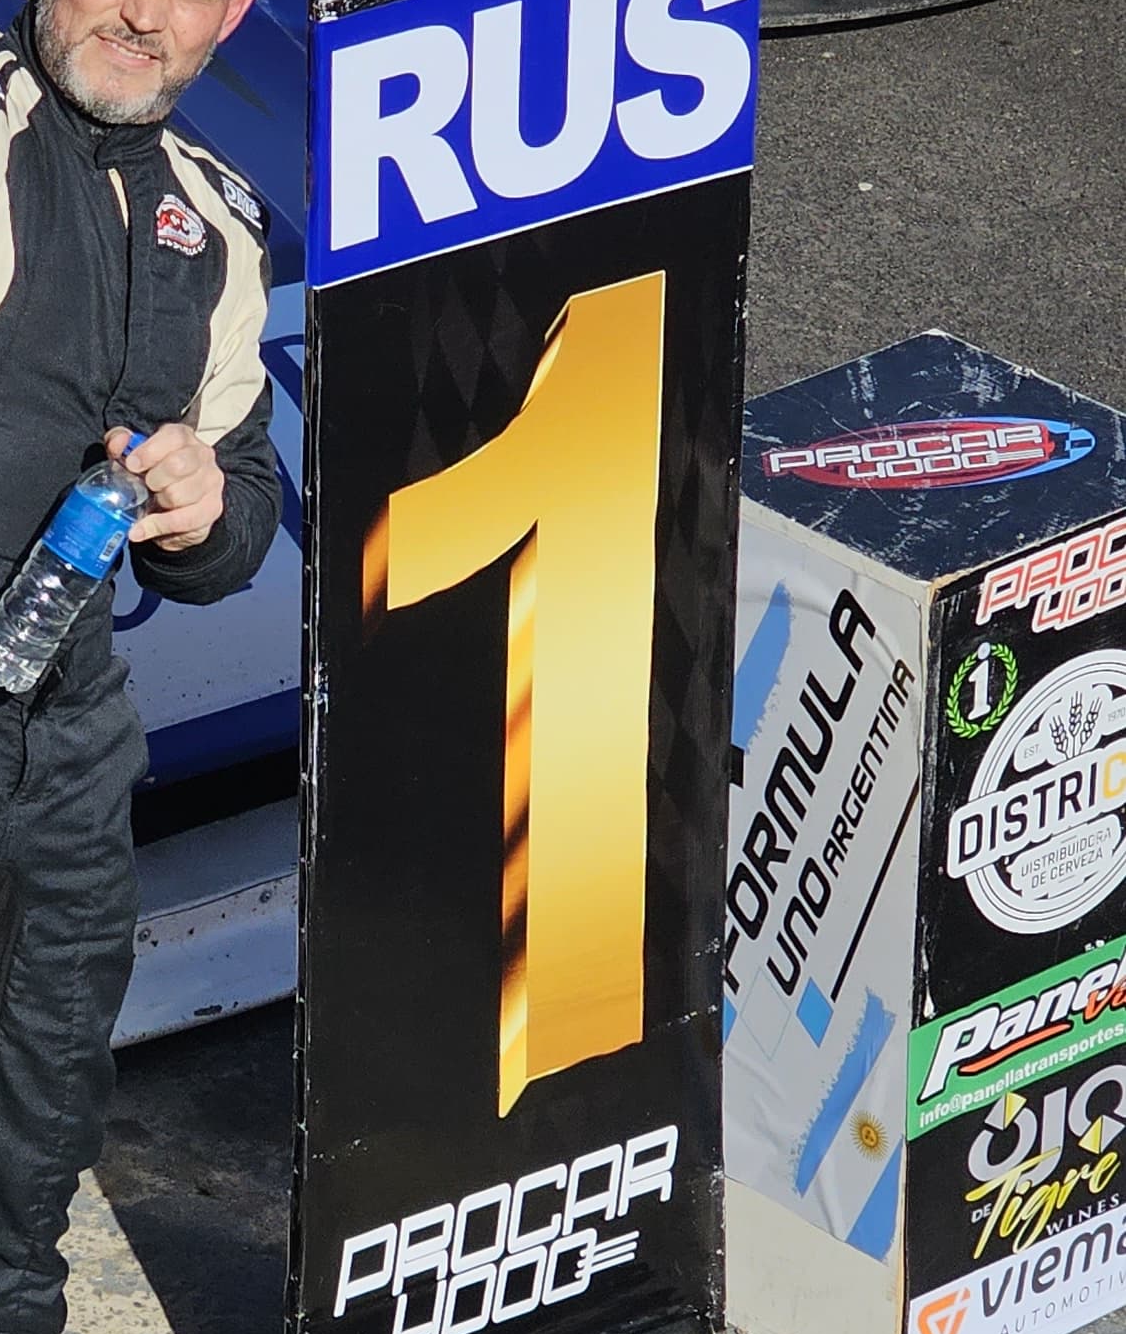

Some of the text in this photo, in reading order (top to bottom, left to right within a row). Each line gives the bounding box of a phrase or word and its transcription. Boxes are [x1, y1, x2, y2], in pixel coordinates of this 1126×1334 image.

[769, 423, 1044, 474] PROCAR
[361, 268, 667, 1118] 1
[766, 659, 915, 997] UNO ARGENTINA
[1031, 848, 1104, 889] DE CERVEZA
[333, 1124, 679, 1318] PROCAR
[965, 1151, 1122, 1260] DE Tigre
[1045, 1192, 1120, 1236] WINES
